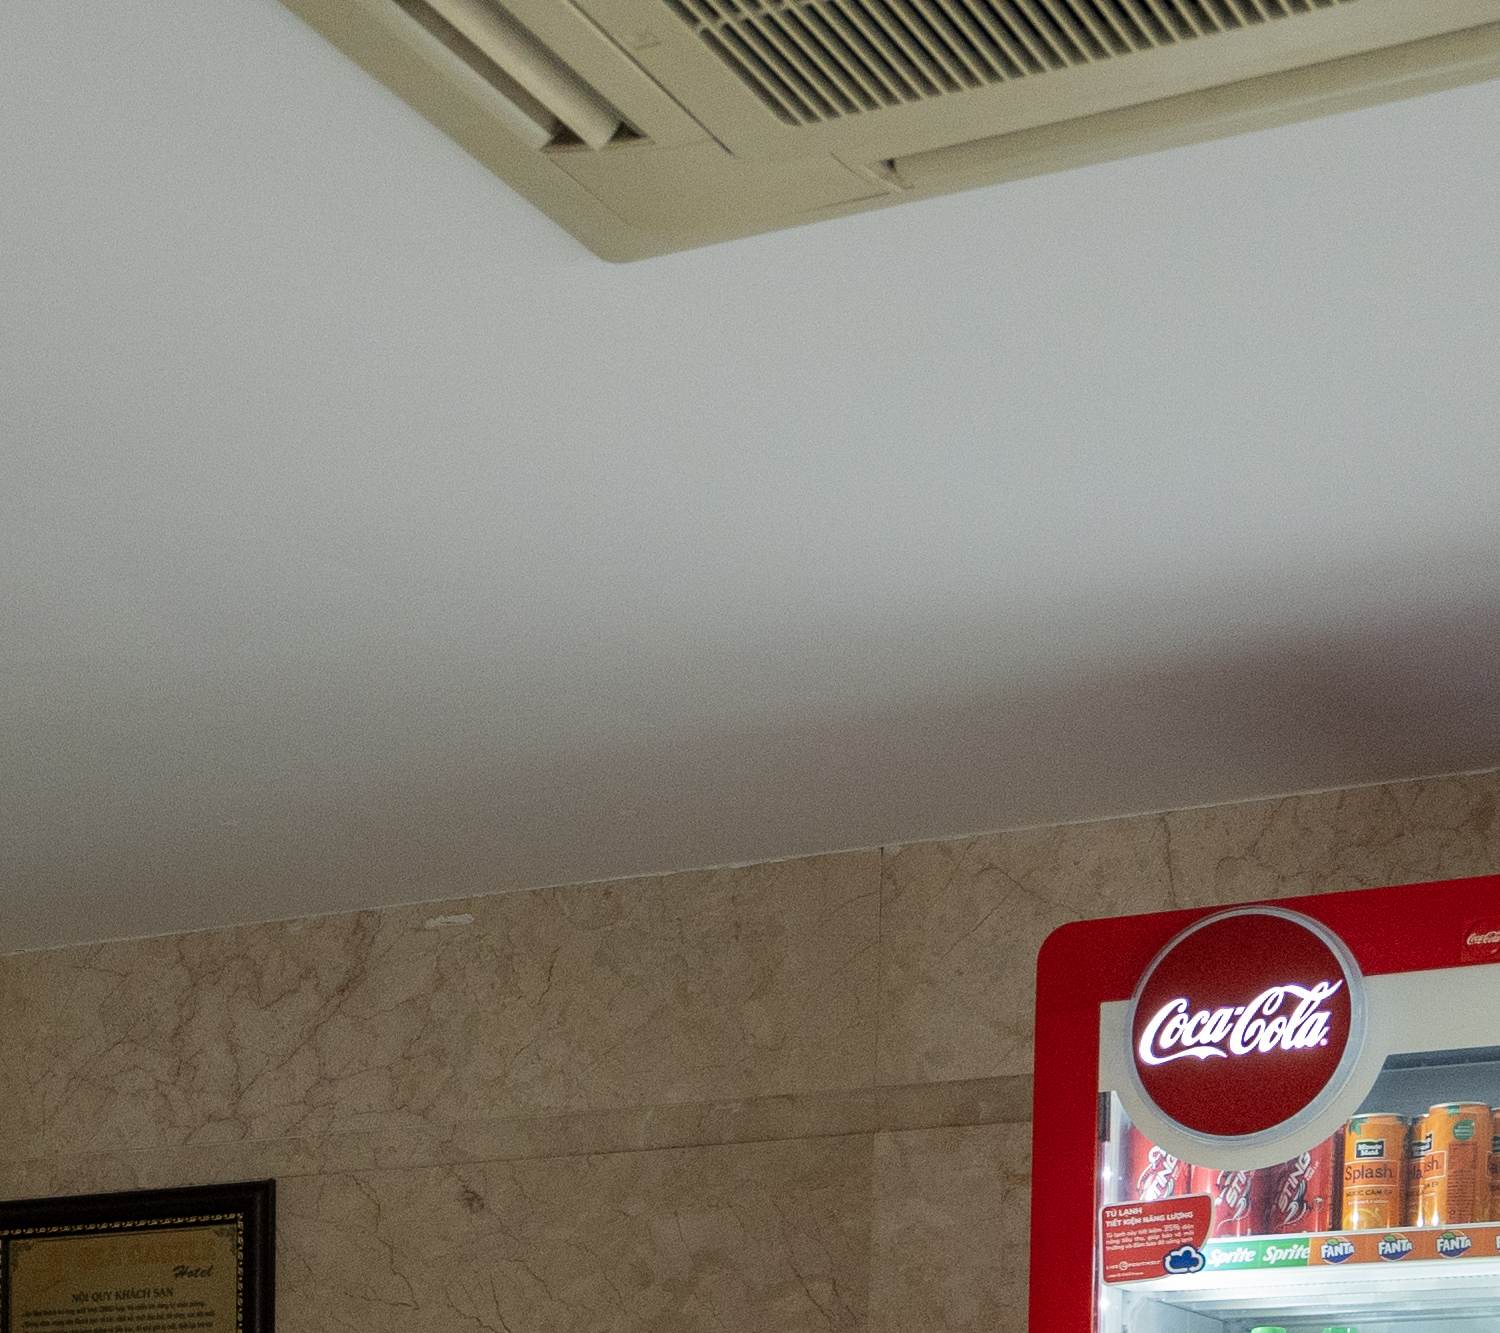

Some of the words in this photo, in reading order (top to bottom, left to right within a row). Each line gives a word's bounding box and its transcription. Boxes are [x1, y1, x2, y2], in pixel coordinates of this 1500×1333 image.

[1138, 979, 1343, 1066] Coca-Cola
[1277, 1149, 1312, 1209] STING
[1344, 1163, 1395, 1186] Splash
[1207, 1242, 1257, 1263] Sprite
[1262, 1238, 1310, 1261] Sprite
[1320, 1241, 1355, 1259] FANTA
[1377, 1237, 1413, 1255] FANTA
[1436, 1234, 1472, 1252] FANTA
[172, 1264, 214, 1279] Hotel
[91, 1292, 112, 1303] QUY
[115, 1287, 151, 1300] KHÁCH
